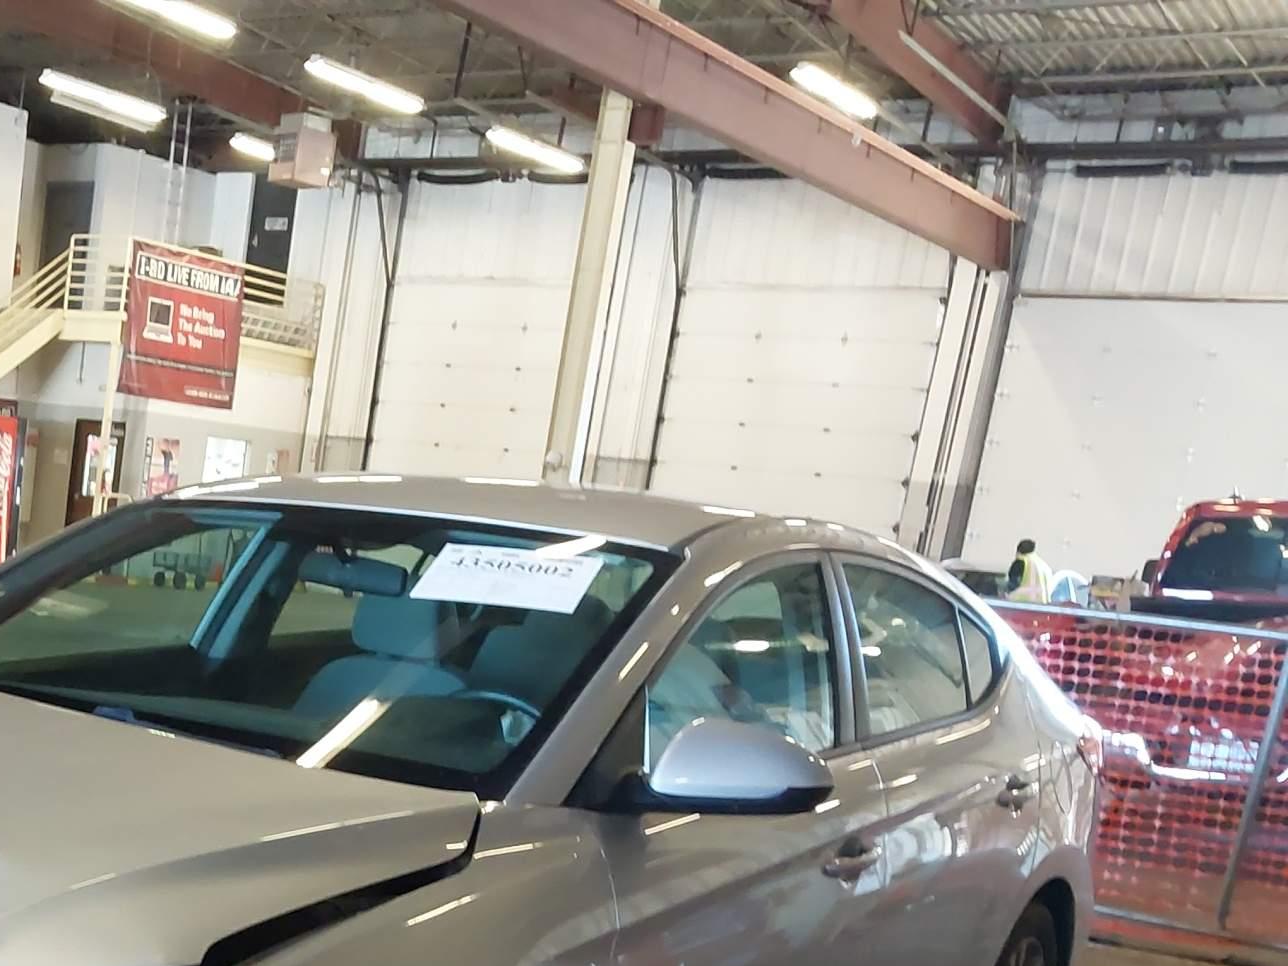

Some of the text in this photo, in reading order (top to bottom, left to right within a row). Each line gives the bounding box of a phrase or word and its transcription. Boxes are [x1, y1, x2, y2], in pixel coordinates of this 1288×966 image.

[166, 263, 189, 286] LIVE
[190, 269, 219, 293] FROM
[178, 318, 226, 339] The Auction
[177, 331, 203, 350] To You
